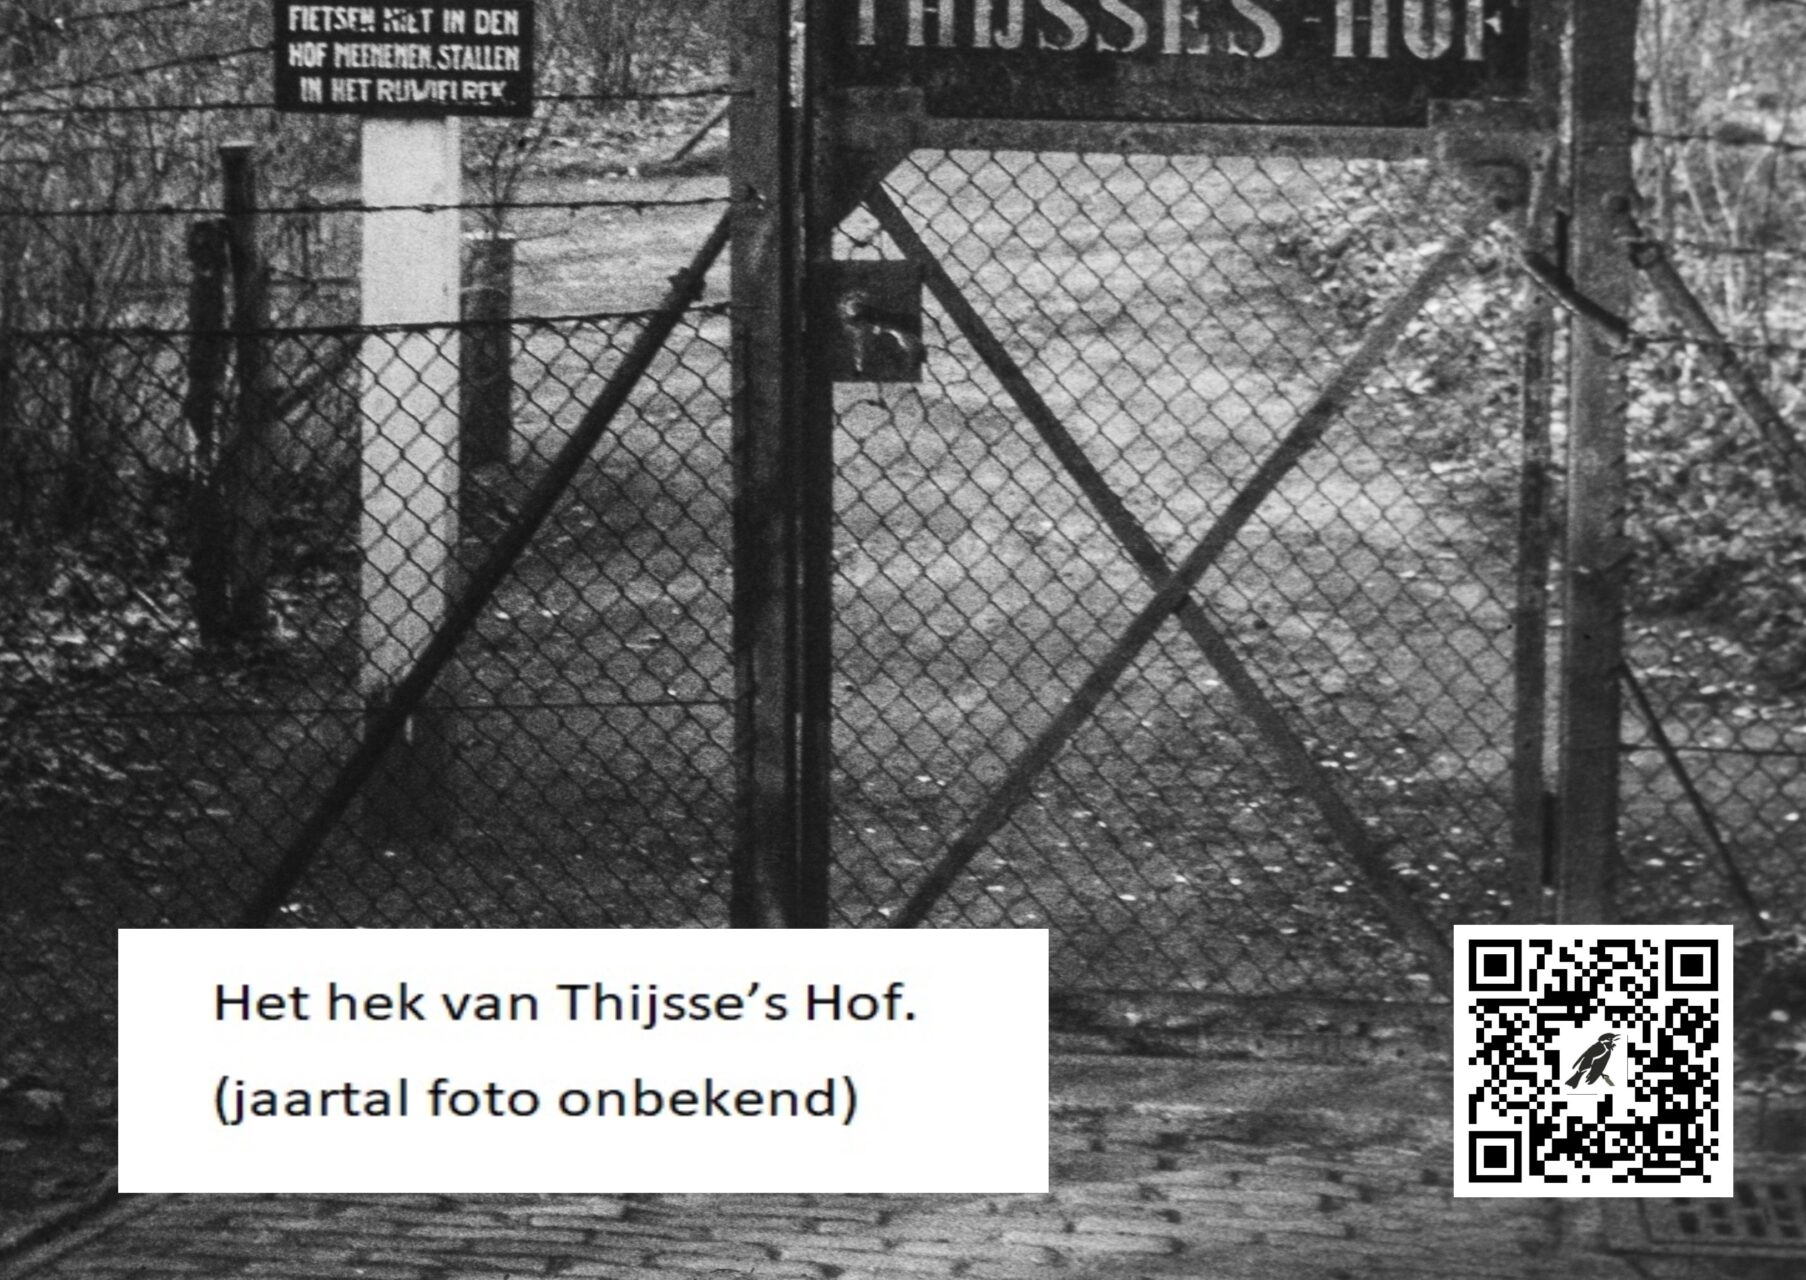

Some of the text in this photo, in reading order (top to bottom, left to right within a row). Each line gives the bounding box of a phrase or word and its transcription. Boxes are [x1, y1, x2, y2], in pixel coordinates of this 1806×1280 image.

[288, 4, 520, 36] FIETSEN NIET IN DEN
[288, 41, 328, 68] HOF
[436, 44, 521, 71] STALLEN
[300, 77, 322, 103] IN
[331, 77, 373, 103] HET
